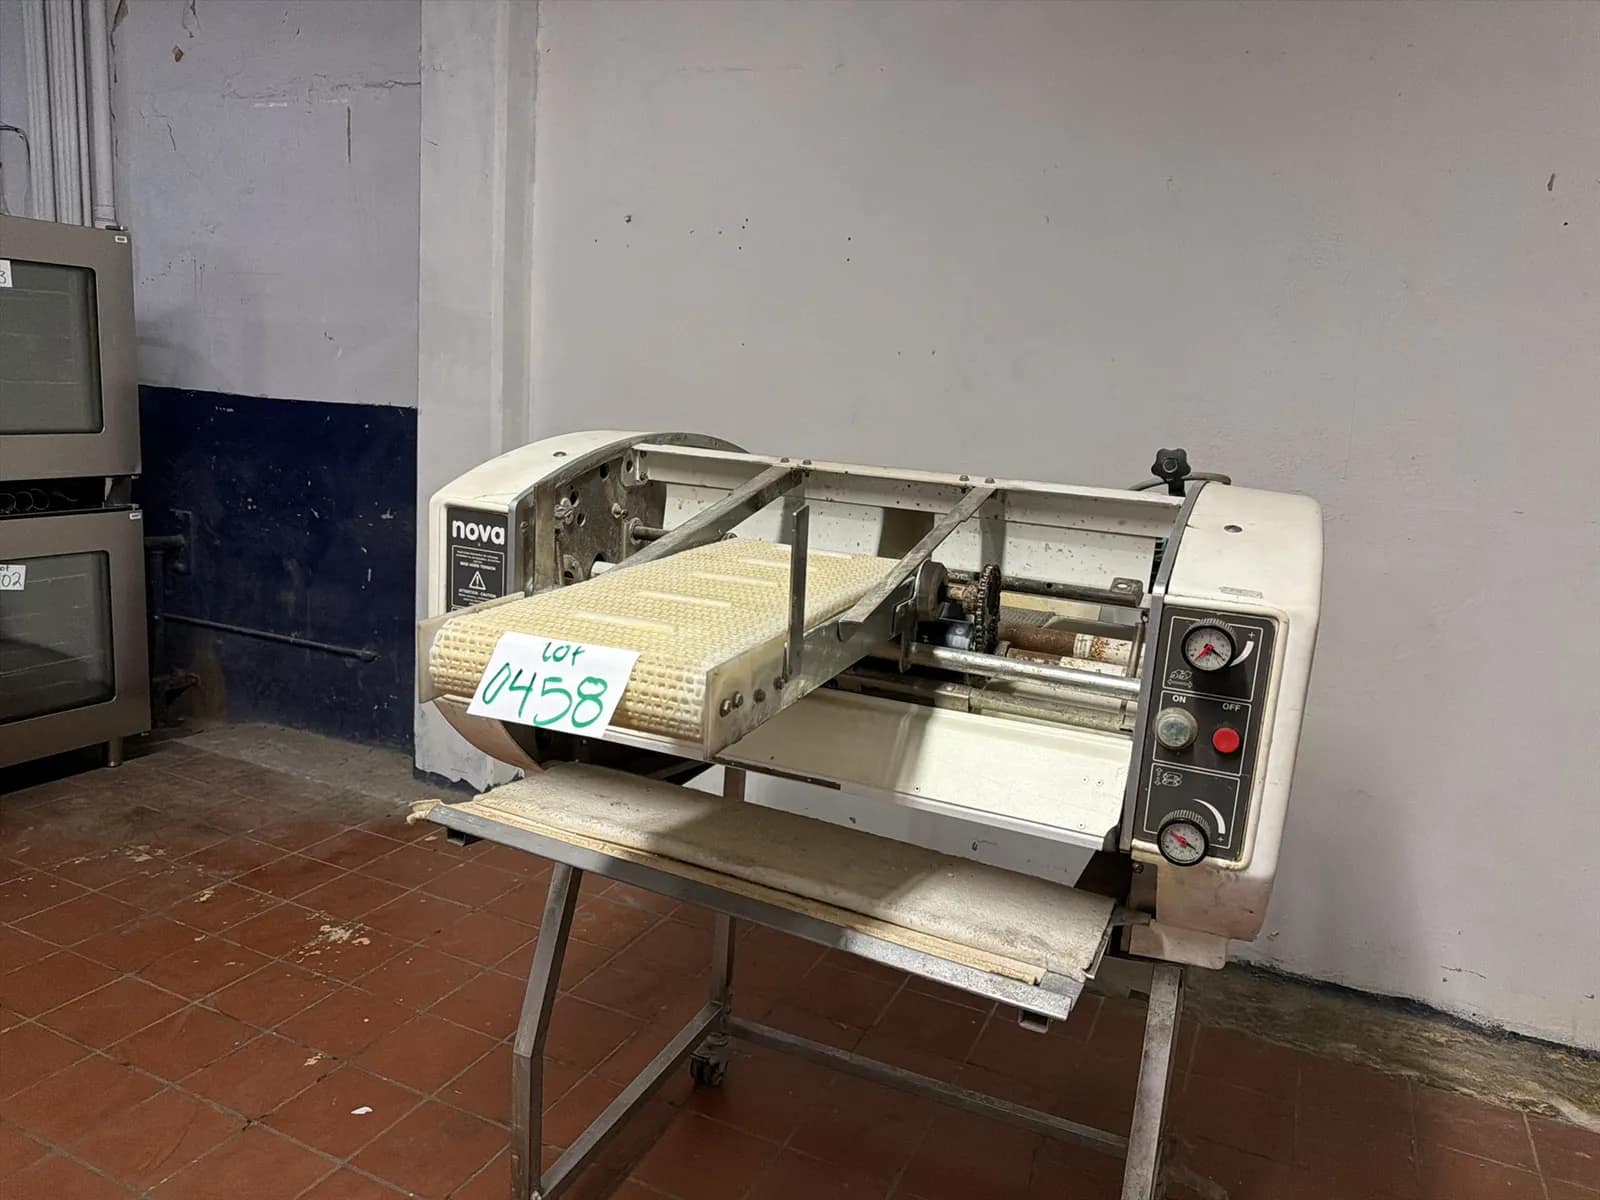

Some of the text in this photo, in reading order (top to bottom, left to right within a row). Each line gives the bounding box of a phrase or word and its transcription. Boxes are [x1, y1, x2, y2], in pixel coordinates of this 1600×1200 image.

[452, 520, 505, 545] nova
[482, 662, 608, 728] 0458
[1172, 694, 1187, 704] ON
[1222, 702, 1241, 712] OFF
